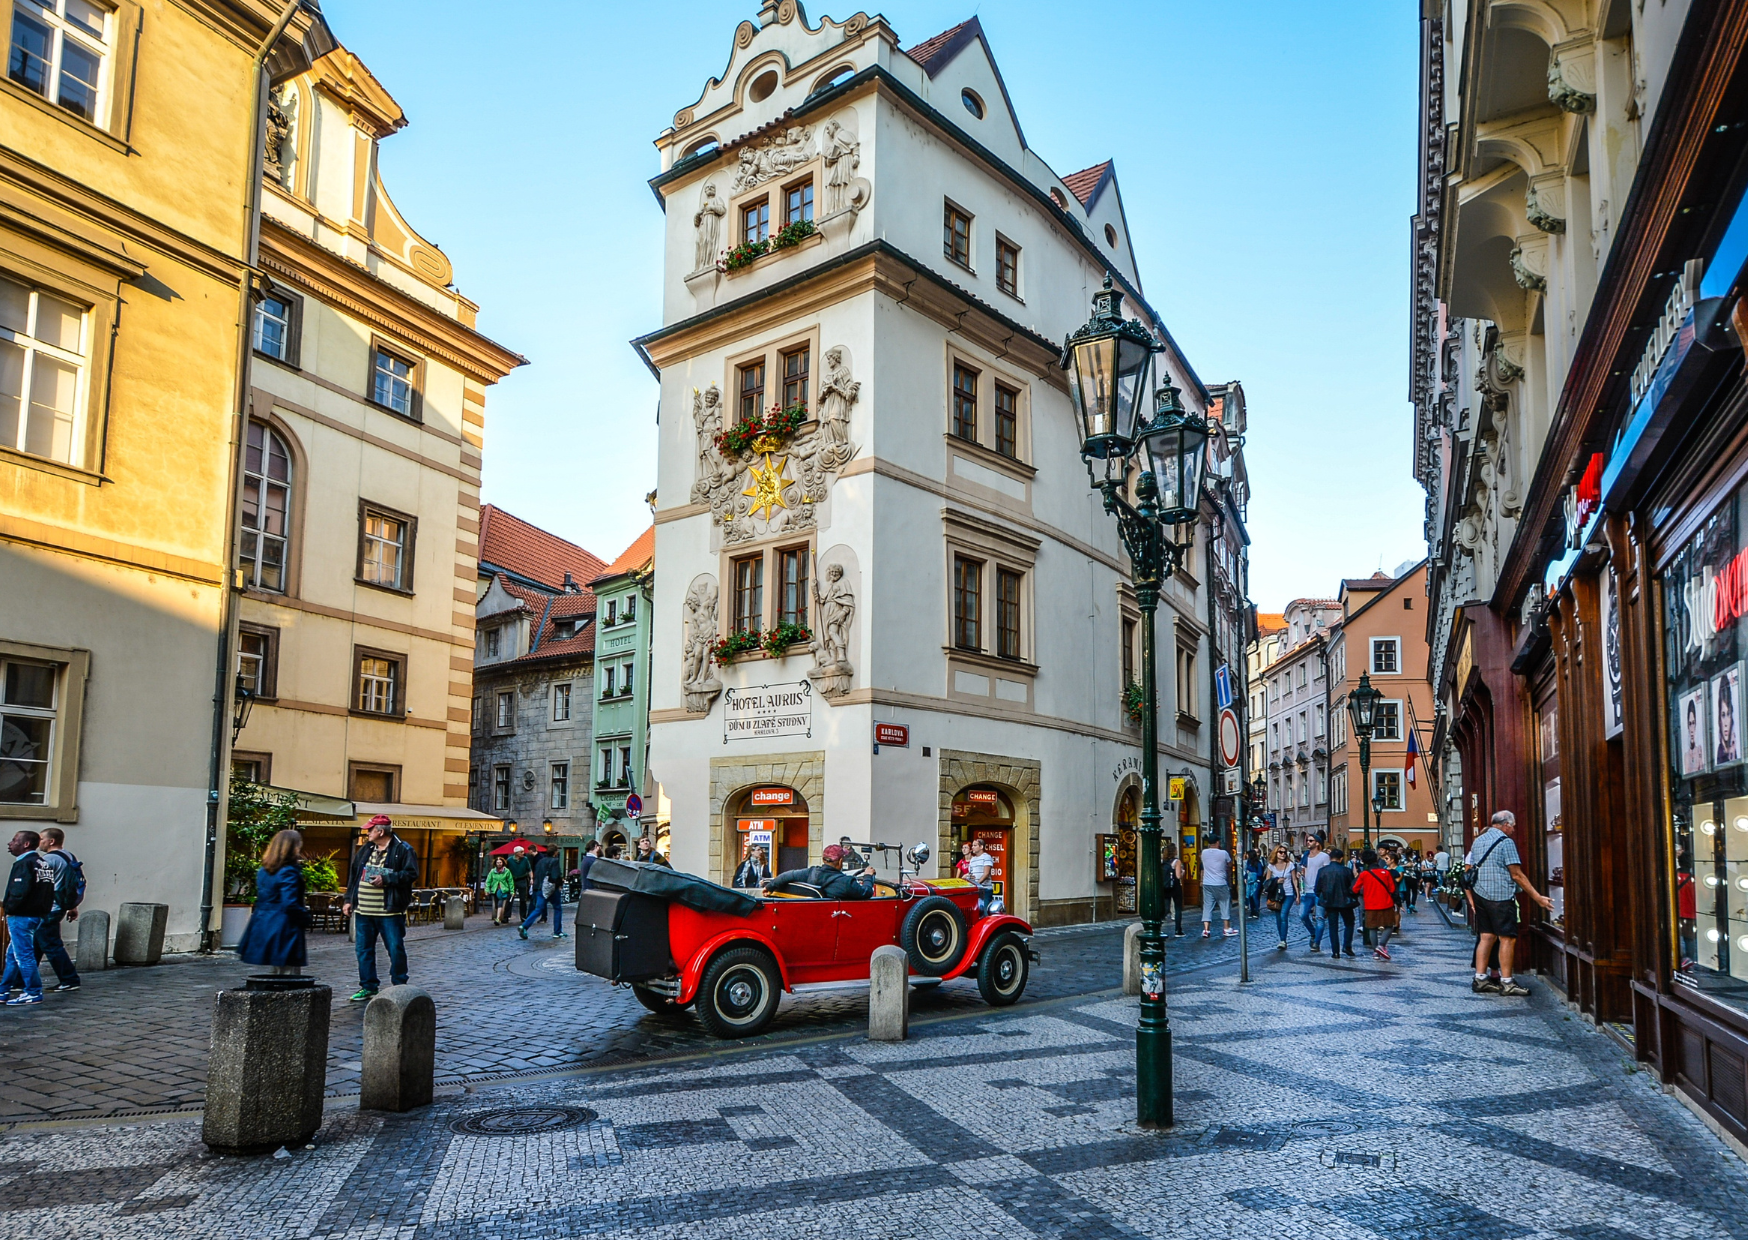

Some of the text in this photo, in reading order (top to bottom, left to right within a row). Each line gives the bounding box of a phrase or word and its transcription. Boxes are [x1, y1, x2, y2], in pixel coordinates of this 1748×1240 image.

[610, 636, 632, 648] HOTEL
[732, 692, 803, 711] HOTEL AURUS
[777, 716, 807, 728] STUDNY
[881, 728, 904, 737] KARLOVA
[1112, 756, 1143, 782] KERAMI
[754, 791, 790, 802] change
[392, 820, 441, 828] RESTAURANT
[748, 821, 764, 830] ATM
[984, 843, 1005, 852] CHSEL
[990, 868, 1002, 876] BIO
